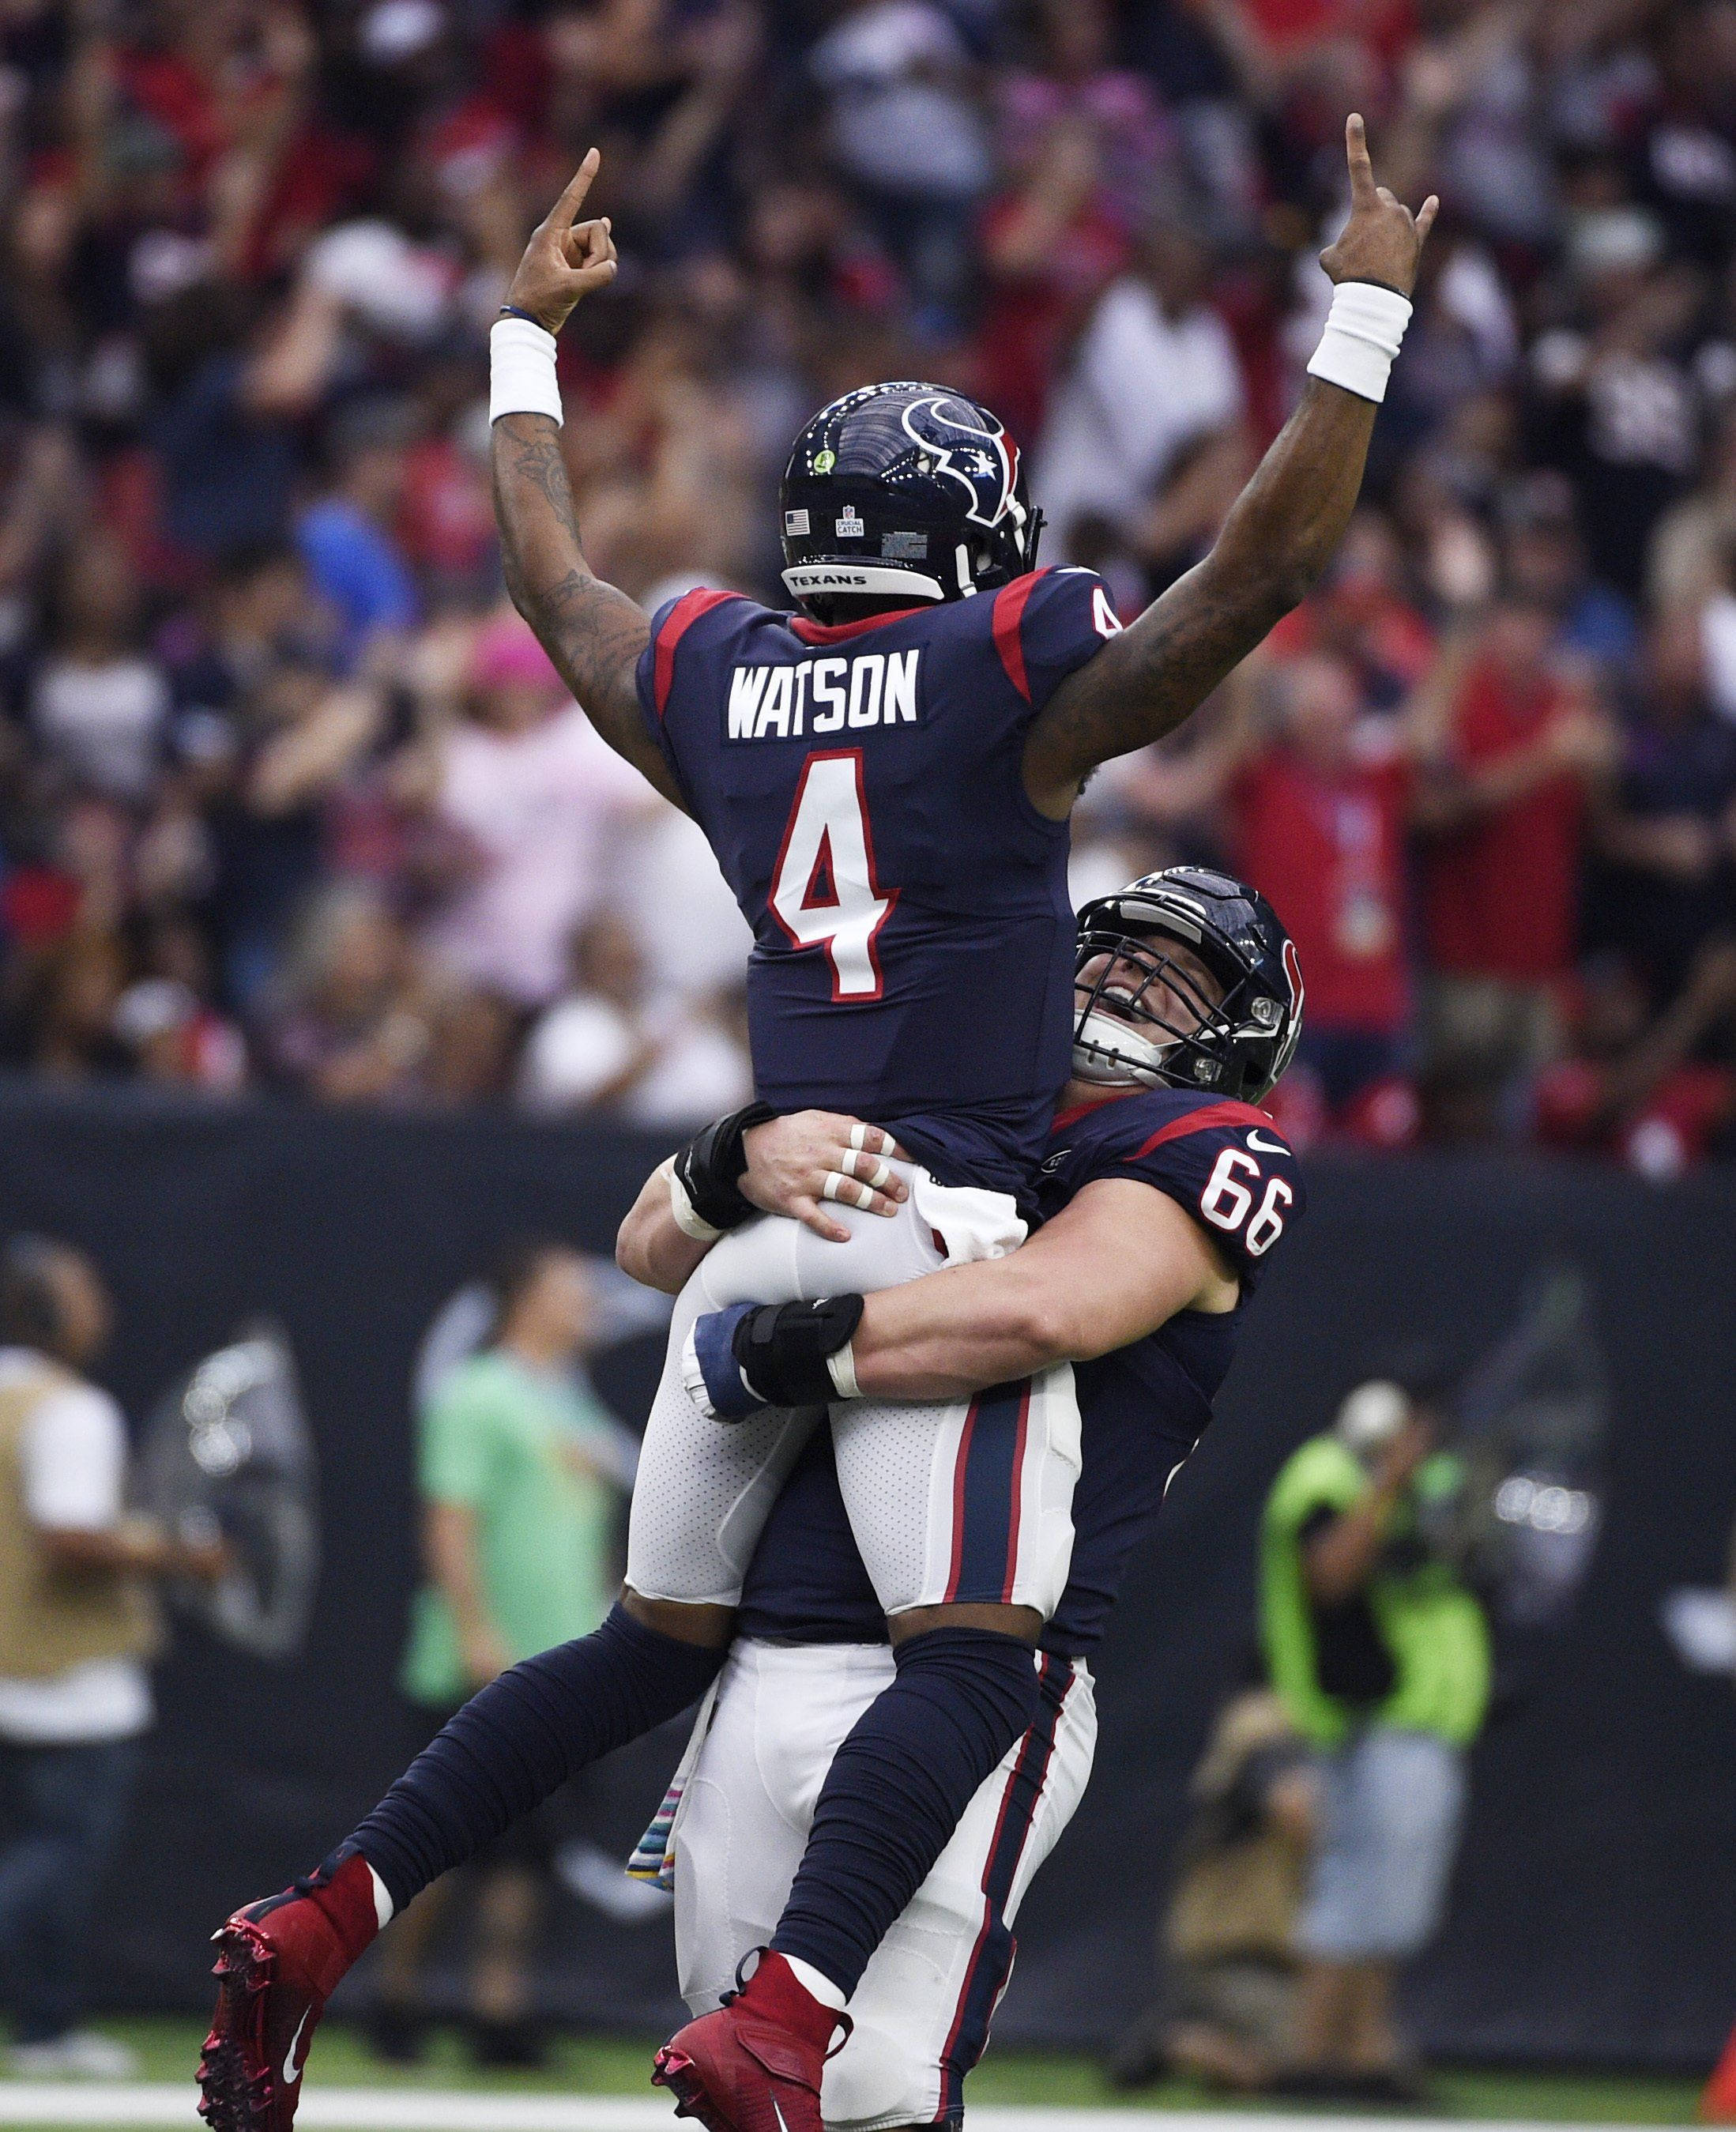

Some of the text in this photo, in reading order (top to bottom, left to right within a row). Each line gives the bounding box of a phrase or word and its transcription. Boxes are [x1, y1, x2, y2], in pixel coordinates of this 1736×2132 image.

[790, 575, 867, 586] TEXANS
[729, 649, 919, 739] WATSON
[766, 747, 902, 1002] 4
[1199, 1145, 1294, 1257] 66
